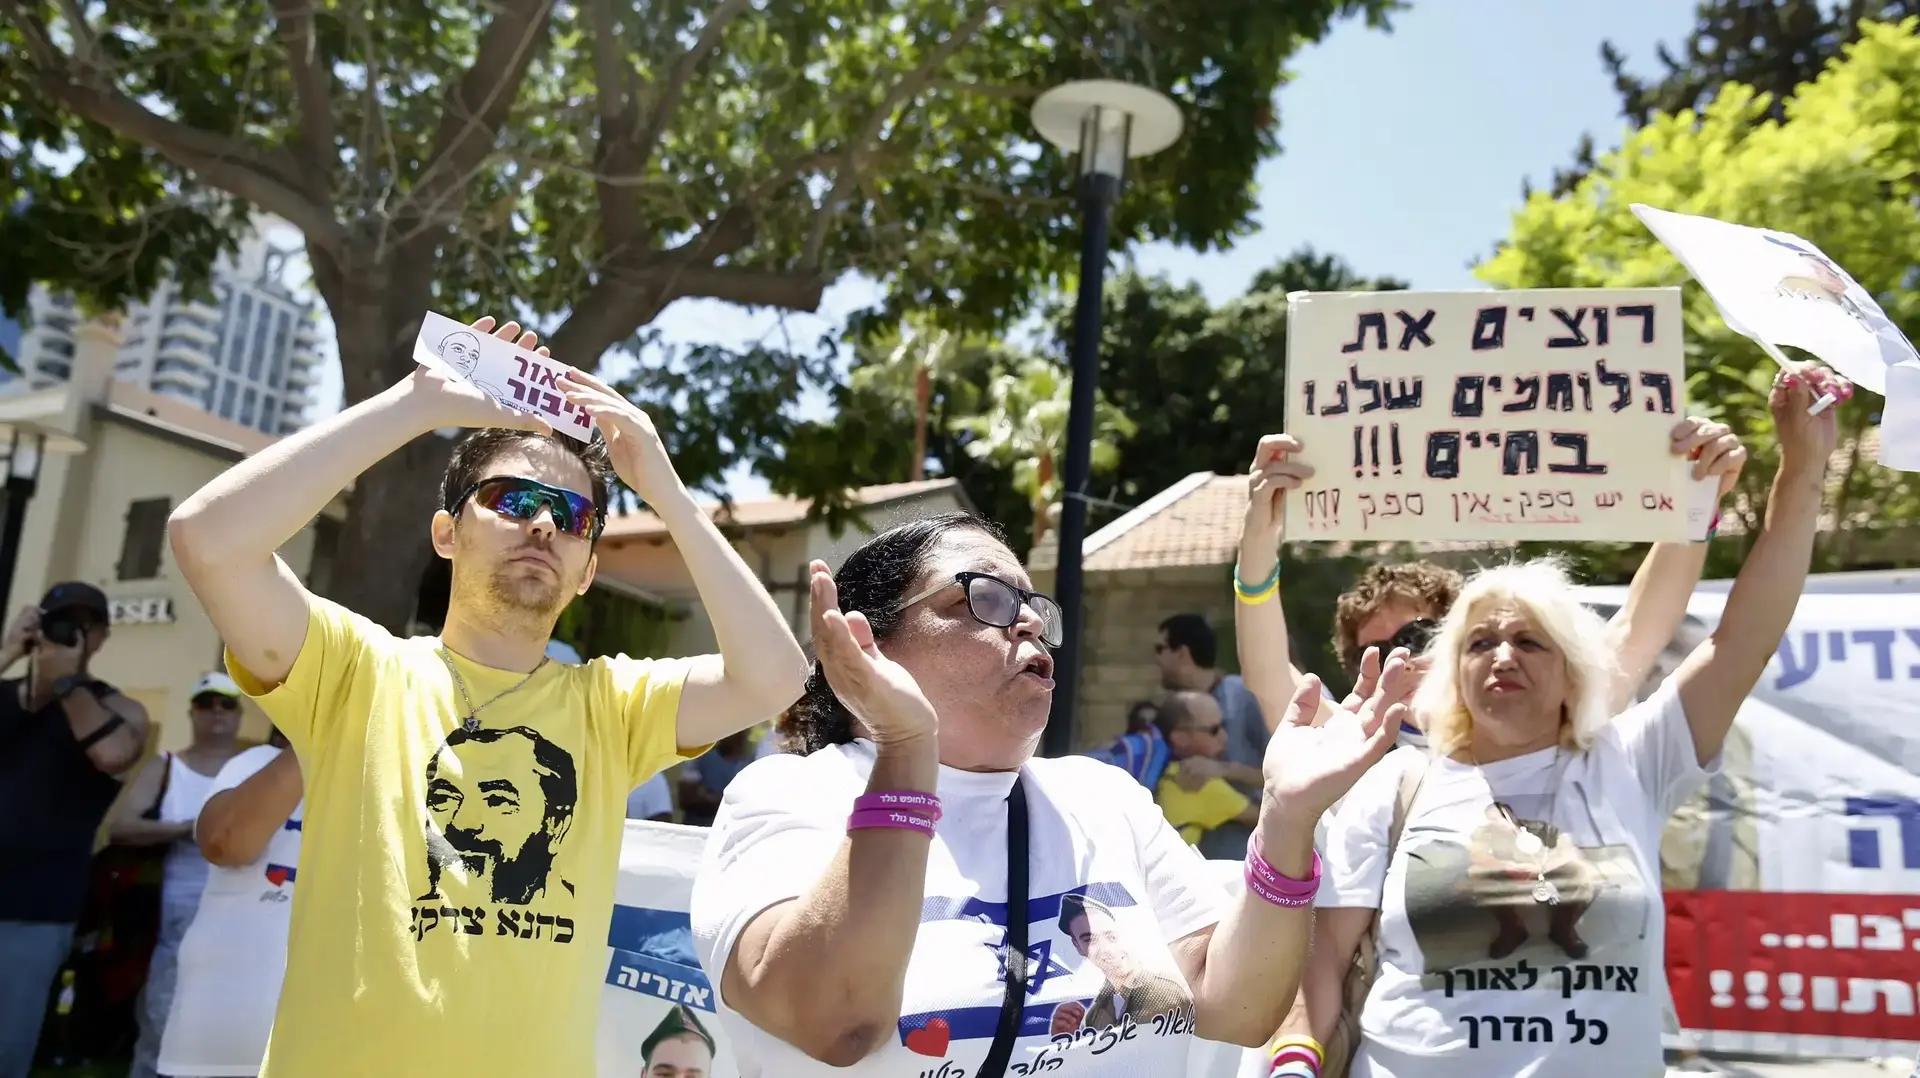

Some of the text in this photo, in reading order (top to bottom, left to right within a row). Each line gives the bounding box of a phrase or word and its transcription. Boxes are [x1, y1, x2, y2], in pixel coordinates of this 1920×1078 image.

[1341, 305, 1655, 353] רוצים את
[513, 355, 574, 392] אור
[1303, 359, 1676, 418] הלוחמים שלנו
[506, 377, 592, 430] גיבור
[1352, 422, 1608, 480] בחיים !!!
[1357, 492, 1425, 530] ספק
[1594, 493, 1623, 509] יש
[1640, 492, 1675, 511] אם
[107, 599, 174, 624] ESEL
[880, 793, 898, 803] נולד
[889, 812, 907, 823] נולד
[496, 908, 575, 944] כהנא
[616, 965, 711, 1008] אזריה
[1435, 958, 1639, 999] איתך לאורך
[1709, 969, 1920, 1016] תו!!!
[1050, 1013, 1138, 1055] אזריה
[1458, 1008, 1609, 1049] כל הדרך
[1010, 1048, 1065, 1076] הילד
